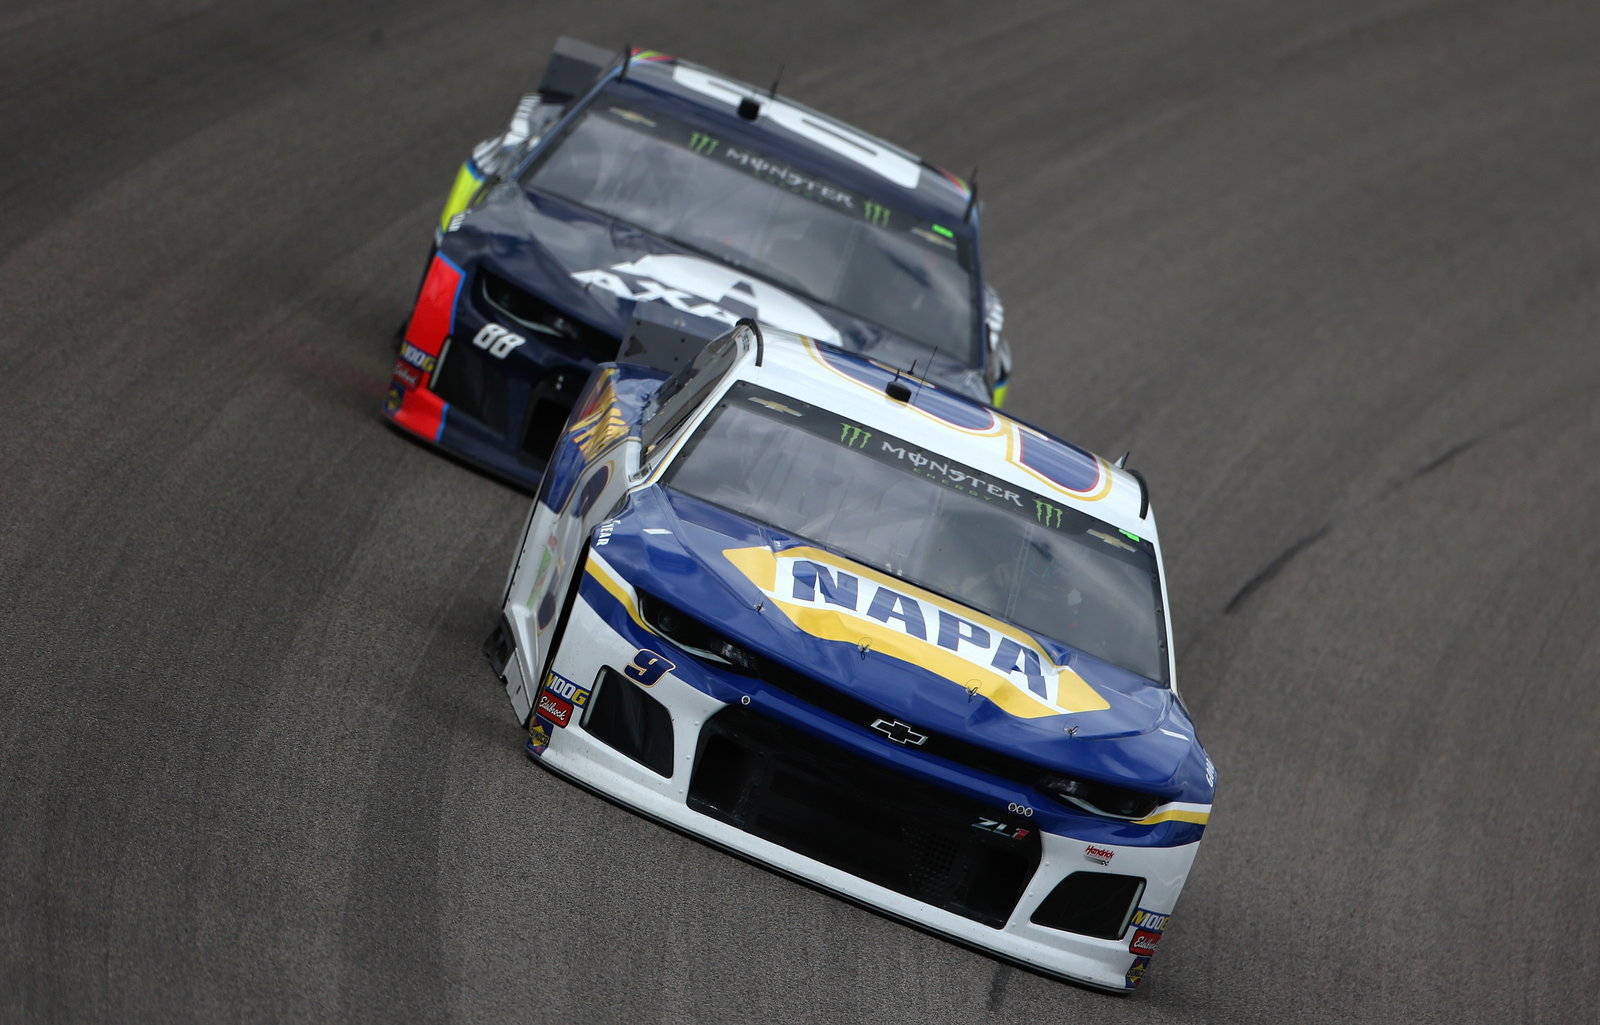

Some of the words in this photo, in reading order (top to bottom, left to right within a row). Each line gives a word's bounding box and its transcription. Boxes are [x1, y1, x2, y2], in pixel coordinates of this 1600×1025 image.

[472, 323, 527, 359] 88
[882, 441, 1024, 508] MONSTER
[792, 560, 1048, 701] NAPA
[624, 648, 677, 688] 9
[971, 816, 1031, 841] ZL1
[1084, 845, 1115, 861] Hendrick
